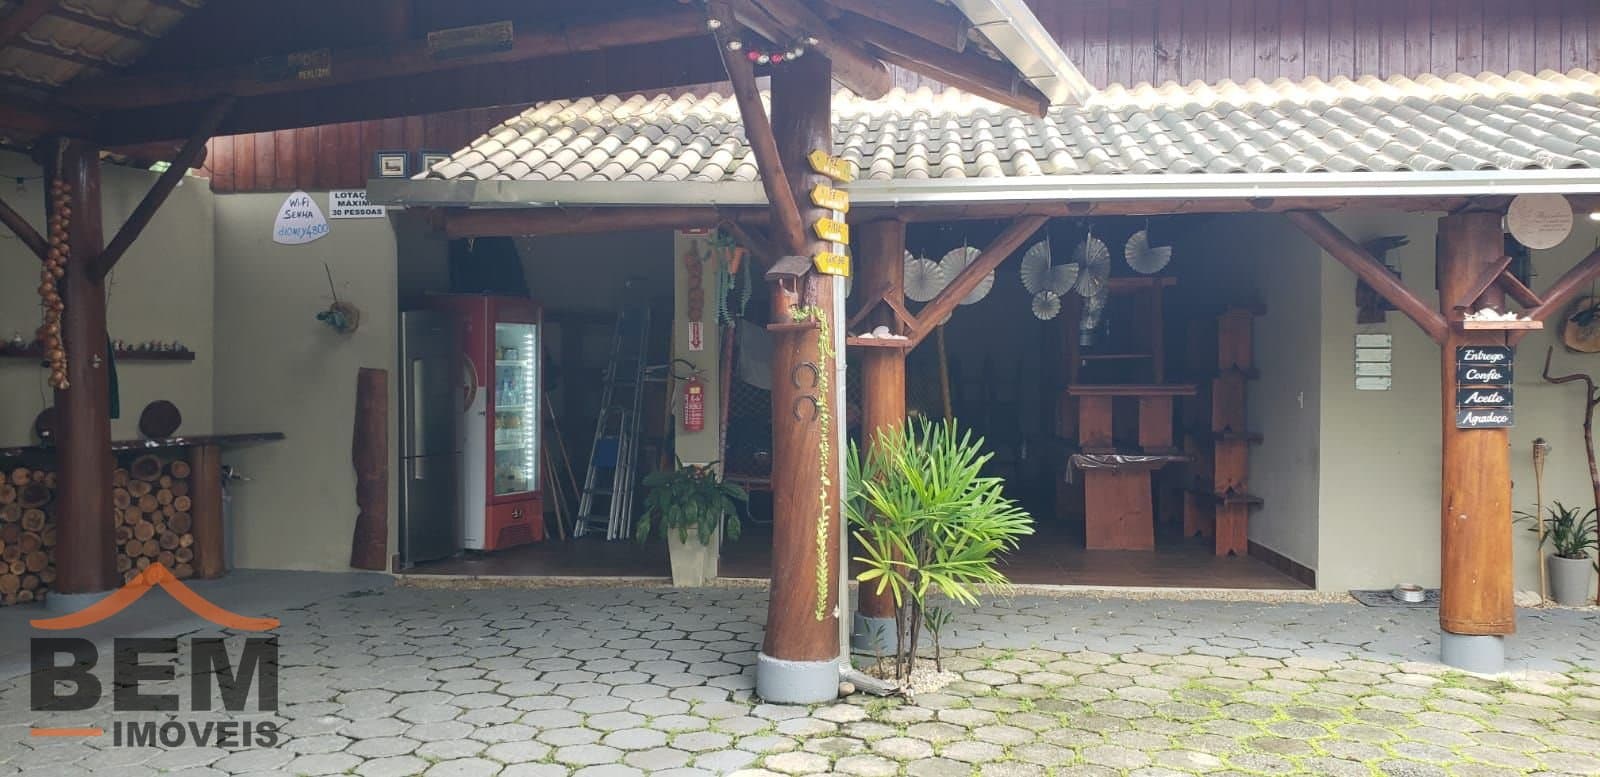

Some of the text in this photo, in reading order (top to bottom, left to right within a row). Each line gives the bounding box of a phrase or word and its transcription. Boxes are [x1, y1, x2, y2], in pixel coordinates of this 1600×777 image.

[283, 209, 314, 219] SENHA
[1463, 349, 1505, 363] Entrego
[1466, 369, 1503, 383] Confio
[1464, 391, 1505, 404] Aceito
